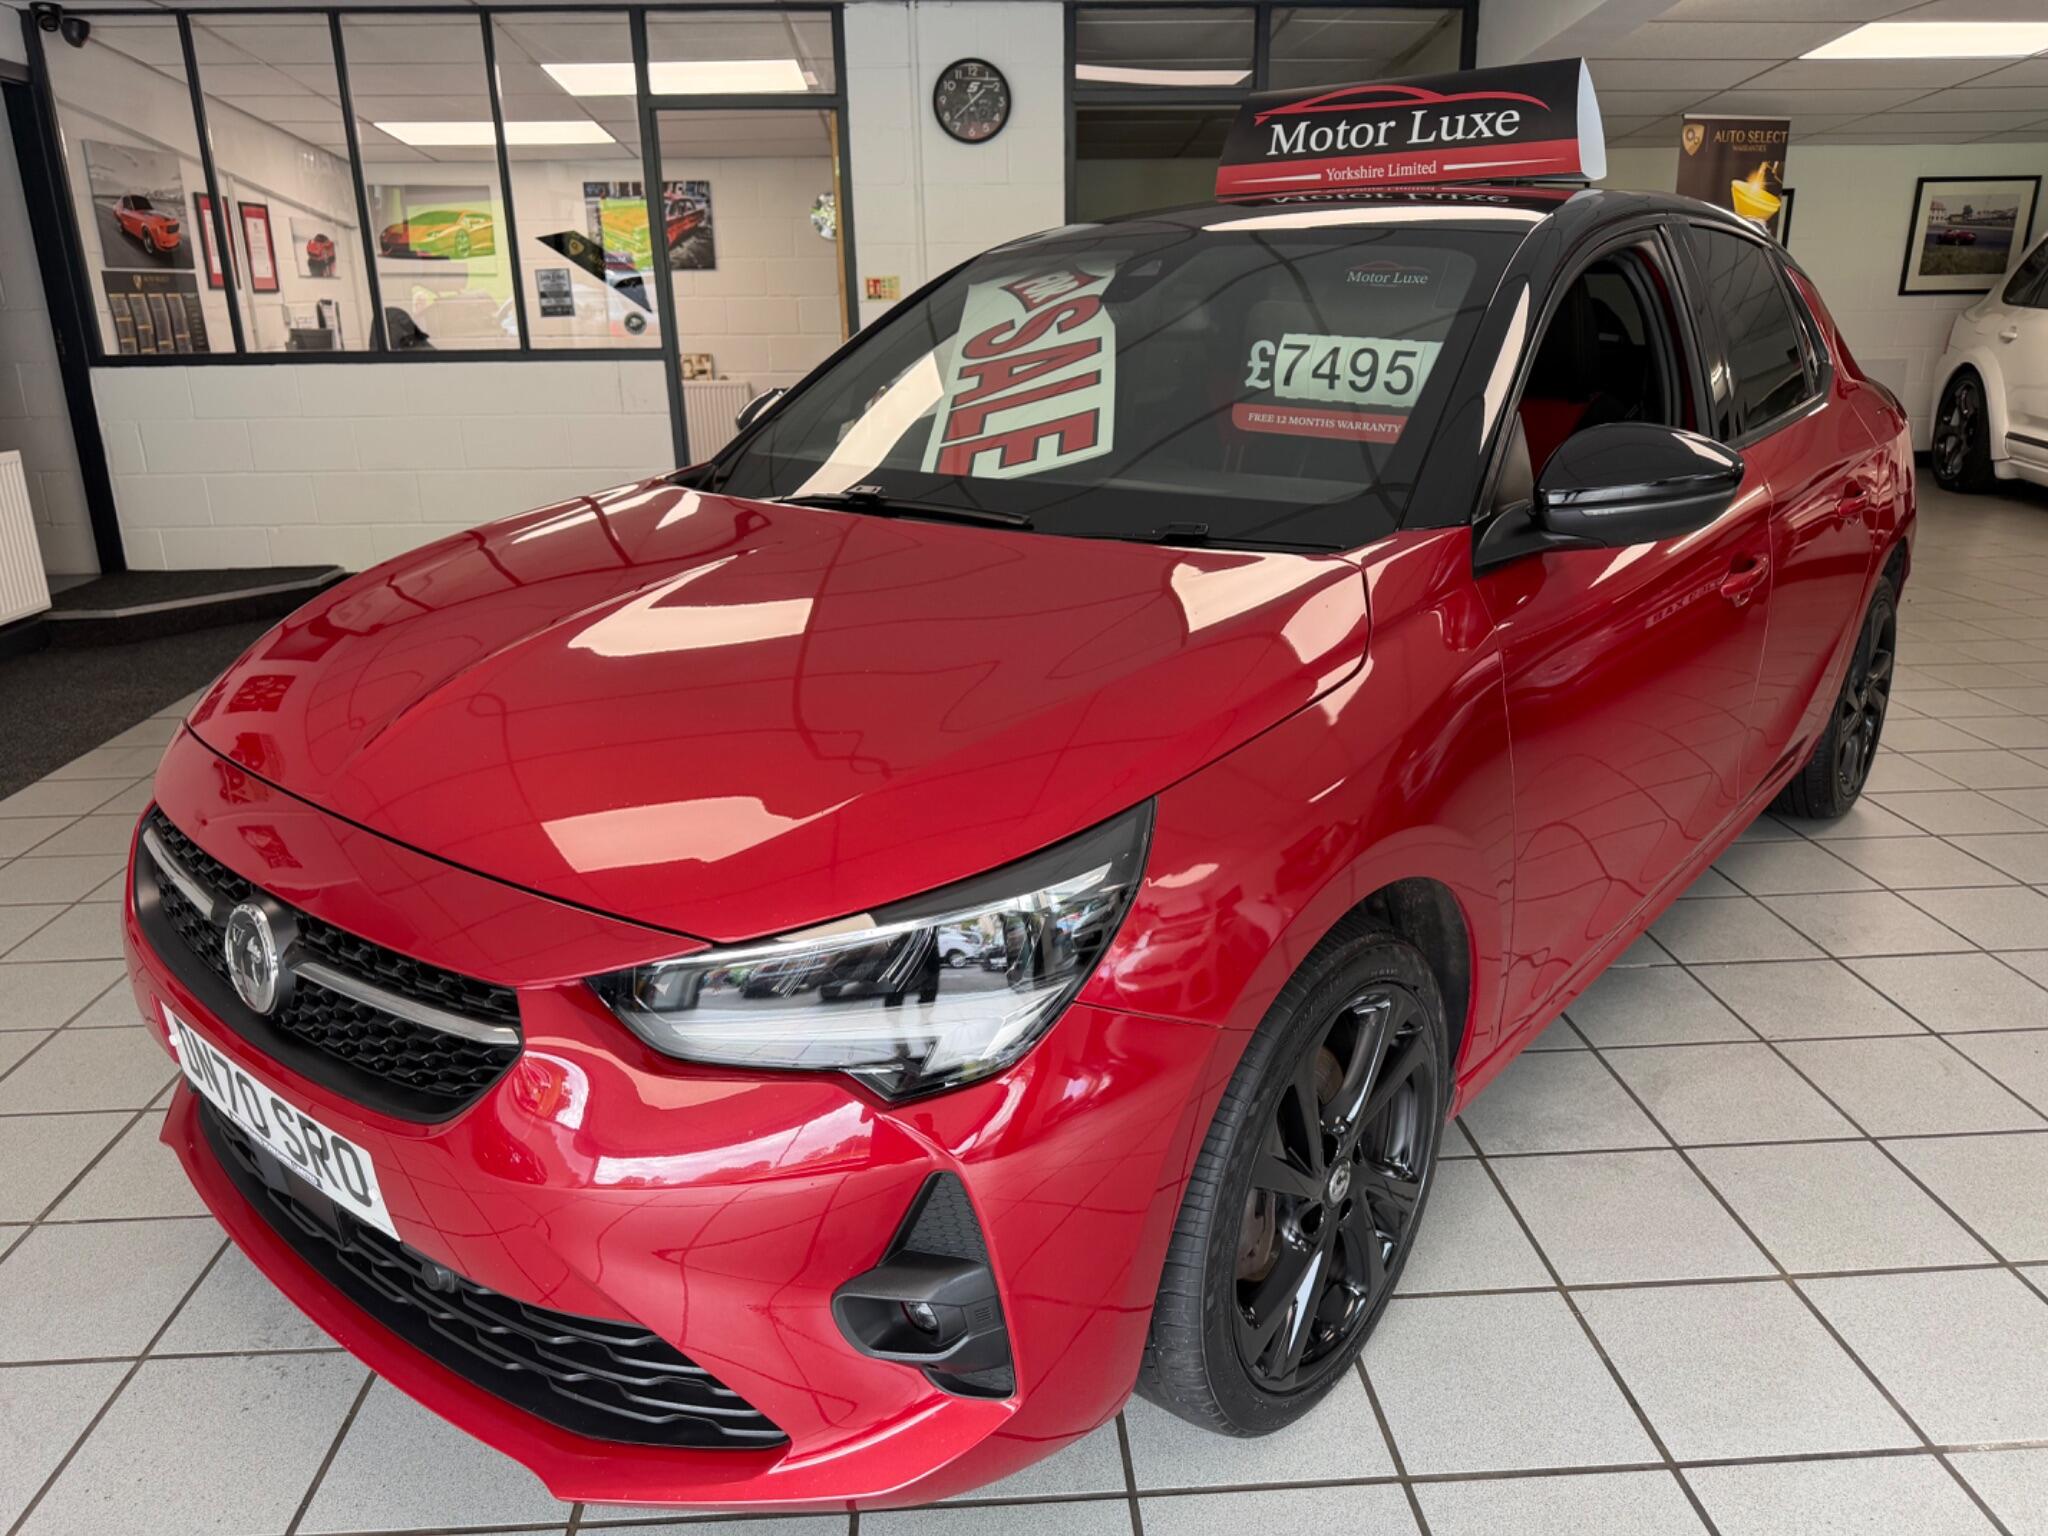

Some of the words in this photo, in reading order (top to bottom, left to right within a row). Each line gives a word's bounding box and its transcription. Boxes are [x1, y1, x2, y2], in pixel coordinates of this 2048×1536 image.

[955, 70, 962, 80] 11
[968, 65, 978, 76] 12
[944, 80, 956, 91] 10
[994, 83, 1000, 92] 2
[940, 96, 947, 105] 9
[999, 97, 1006, 107] 3
[969, 128, 976, 137] 6
[1266, 119, 1396, 157] Motor
[1406, 108, 1520, 145] Luxe
[1713, 129, 1745, 144] AUTO
[1747, 130, 1788, 144] SELECT
[1326, 165, 1384, 182] Yorkshire
[1388, 160, 1437, 178] Limited
[1346, 271, 1391, 283] Motor
[1392, 271, 1428, 284] Luxe
[1244, 339, 1417, 396] £7495
[934, 293, 1103, 478] SALE
[1248, 412, 1274, 423] FREE
[1276, 415, 1288, 424] 12
[1288, 417, 1335, 428] MONTHS
[1337, 420, 1401, 433] WARRANTY
[270, 1097, 373, 1208] SRO
